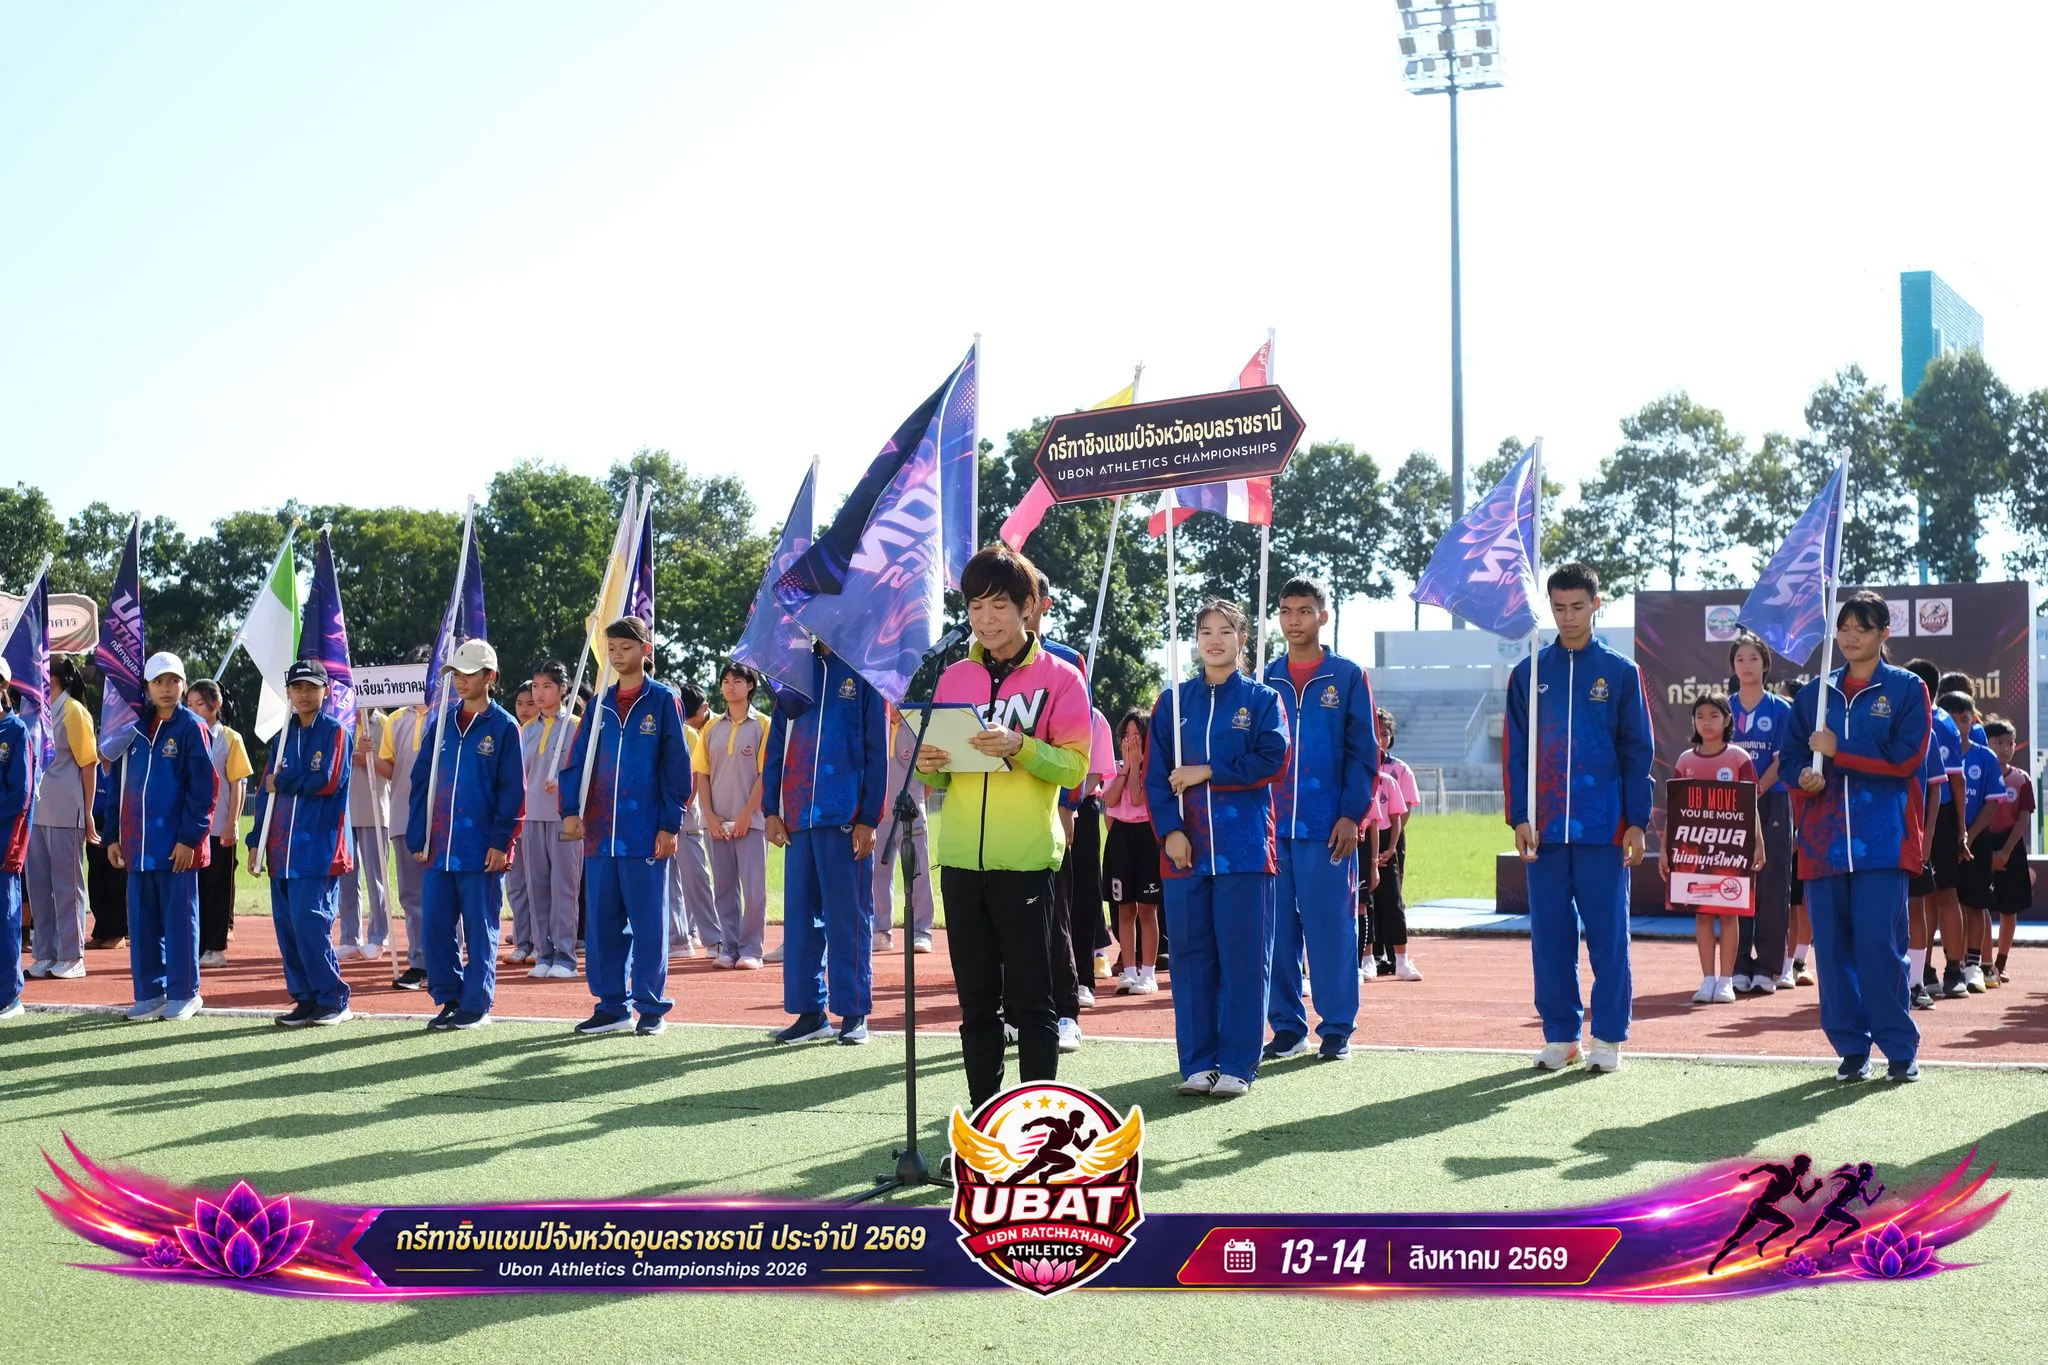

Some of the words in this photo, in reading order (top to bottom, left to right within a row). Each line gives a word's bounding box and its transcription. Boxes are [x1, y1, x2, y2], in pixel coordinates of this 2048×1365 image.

[1057, 465, 1095, 481] UBON
[1098, 456, 1169, 476] ATHLETICS
[1173, 442, 1278, 466] CHAMPIONSHIPS
[1688, 786, 1702, 809] UB
[1707, 788, 1737, 811] MOVE
[1681, 809, 1701, 818] YOU
[1703, 810, 1714, 819] BE
[1716, 811, 1744, 821] MOVE
[1675, 825, 1747, 854] คนอุบล
[1112, 878, 1123, 901] 9
